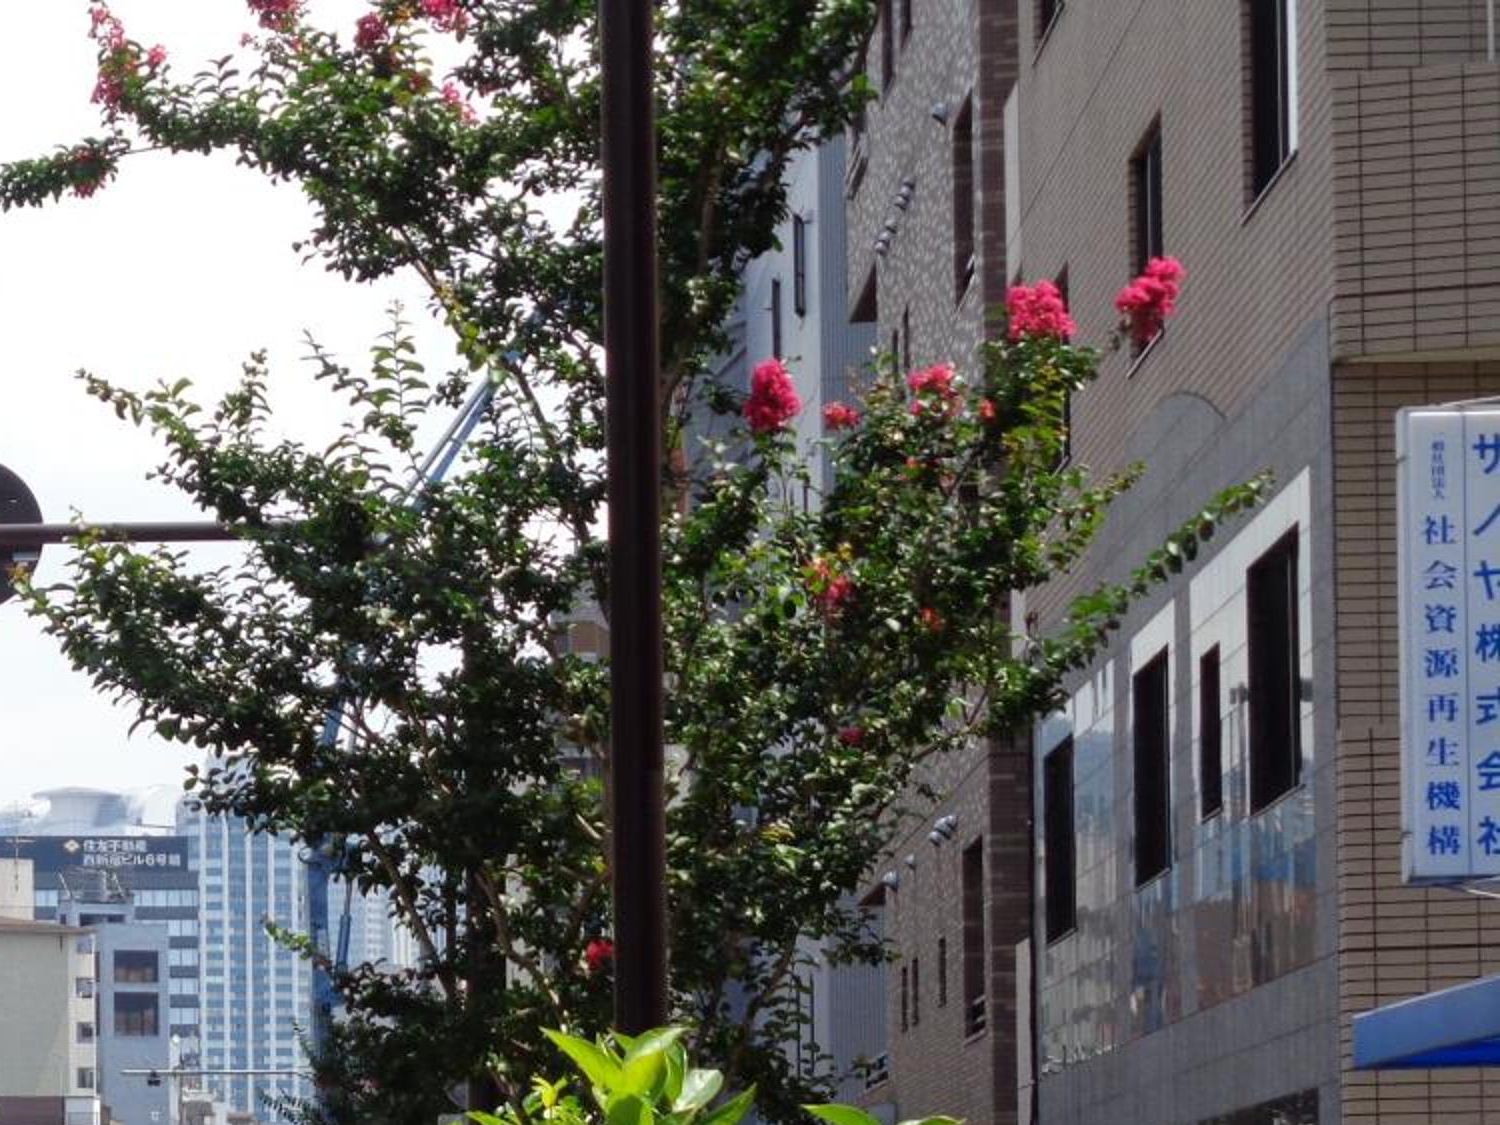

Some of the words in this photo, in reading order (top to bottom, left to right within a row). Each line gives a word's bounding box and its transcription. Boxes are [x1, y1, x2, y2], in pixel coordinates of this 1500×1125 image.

[1420, 514, 1461, 856] 社会資源再生機構
